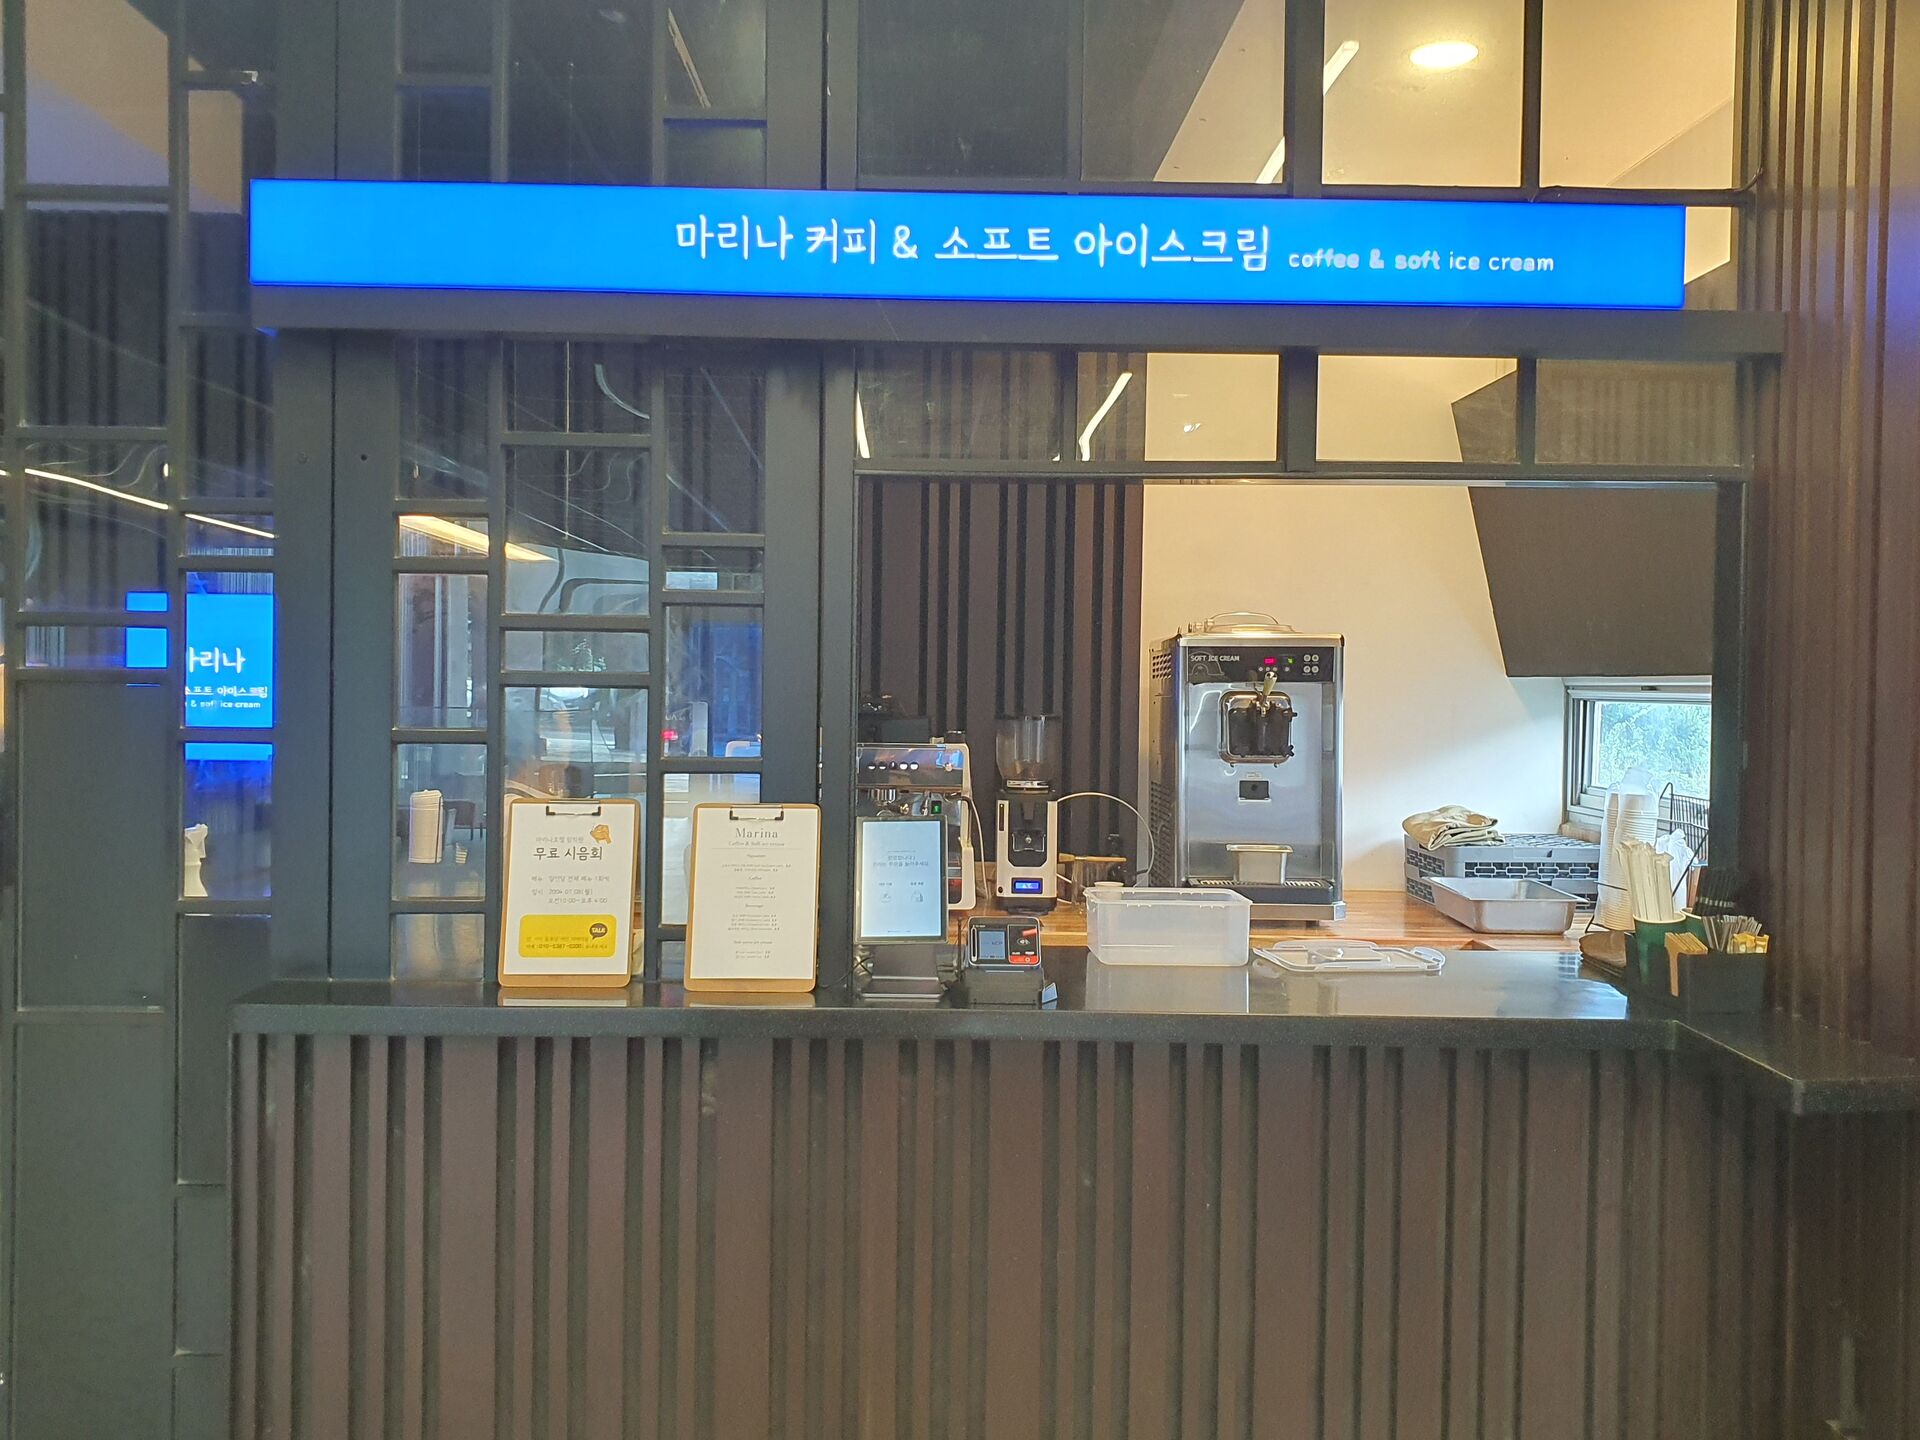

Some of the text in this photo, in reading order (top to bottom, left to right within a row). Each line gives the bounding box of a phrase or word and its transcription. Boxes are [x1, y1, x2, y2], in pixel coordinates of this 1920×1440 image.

[676, 215, 1554, 272] 마리나 커피 & 소프트 아이스크림 coffee & soft ice cream
[735, 827, 778, 839] Marina
[533, 846, 603, 861] 무료 시음회
